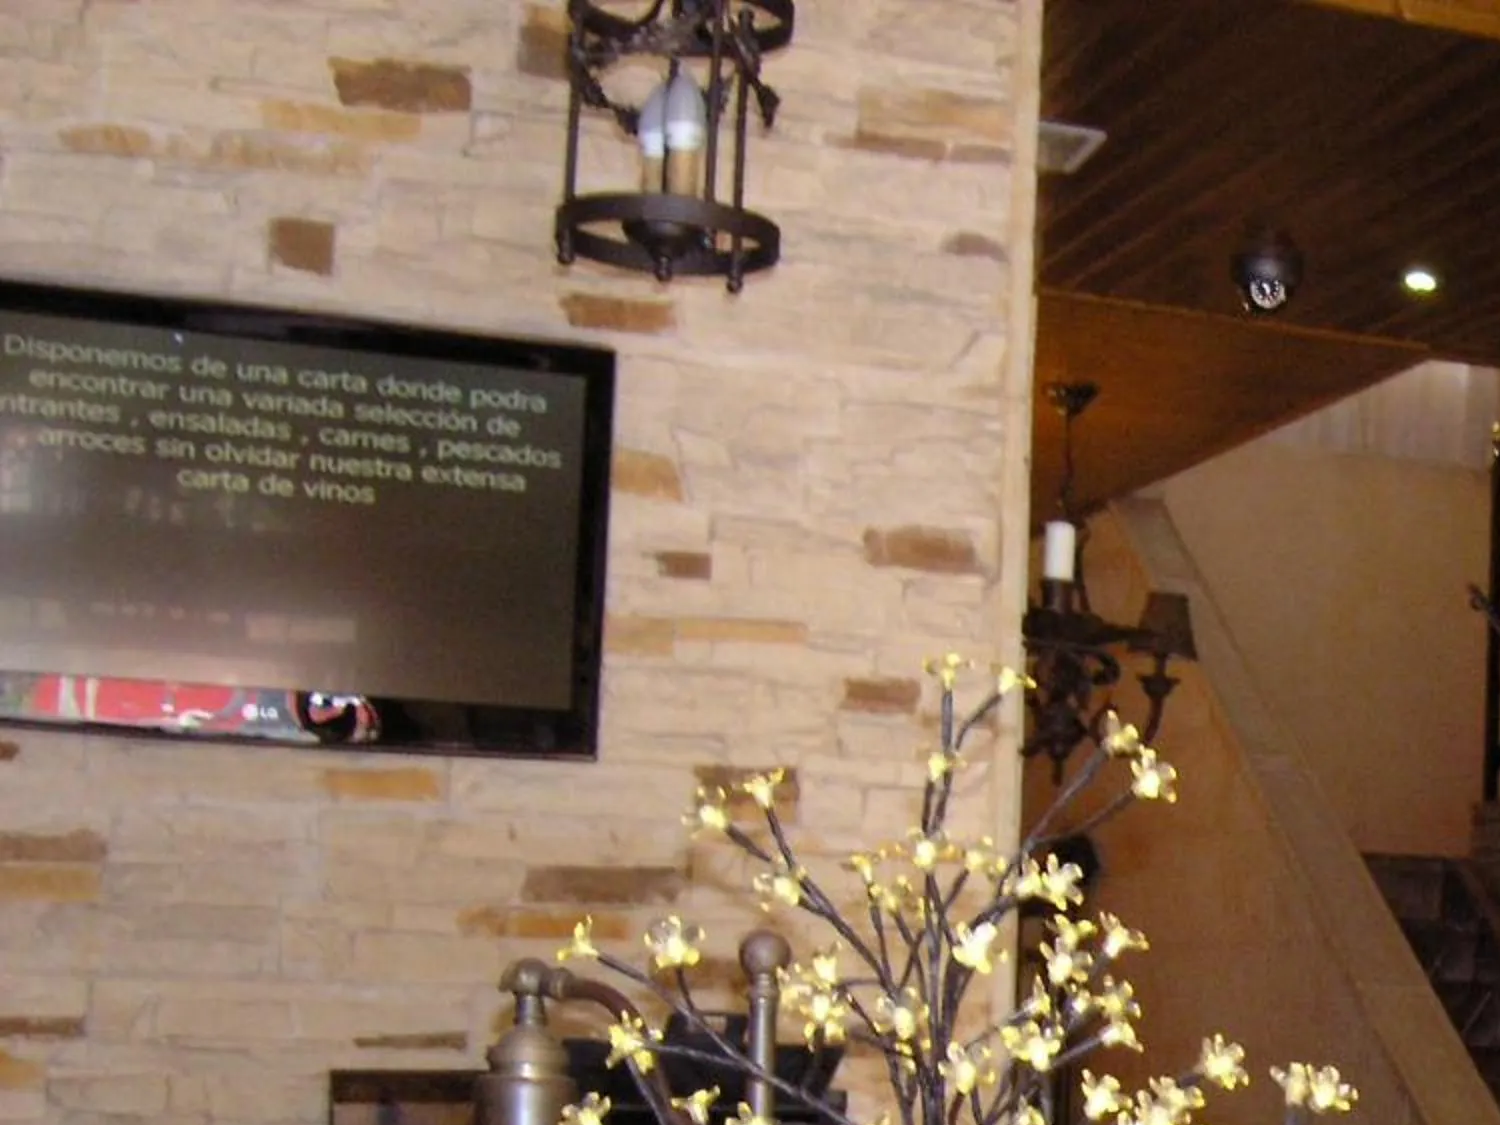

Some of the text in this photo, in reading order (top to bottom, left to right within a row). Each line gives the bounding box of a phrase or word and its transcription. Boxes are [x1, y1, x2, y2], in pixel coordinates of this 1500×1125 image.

[5, 334, 182, 374] Disponemos
[191, 355, 228, 379] de
[236, 362, 289, 385] una
[297, 369, 368, 394] carta
[376, 374, 462, 402] donde
[0, 393, 120, 424] ntrantes
[148, 408, 292, 441] ensaladas
[318, 426, 411, 453] carnes
[436, 438, 563, 470] pescados
[28, 367, 170, 400] encontrar
[178, 383, 233, 407] una
[241, 390, 344, 420] variada
[486, 414, 522, 439] de
[37, 427, 527, 493] arroces sin olvidar nuestra extensa
[176, 468, 376, 504] carta de vinos
